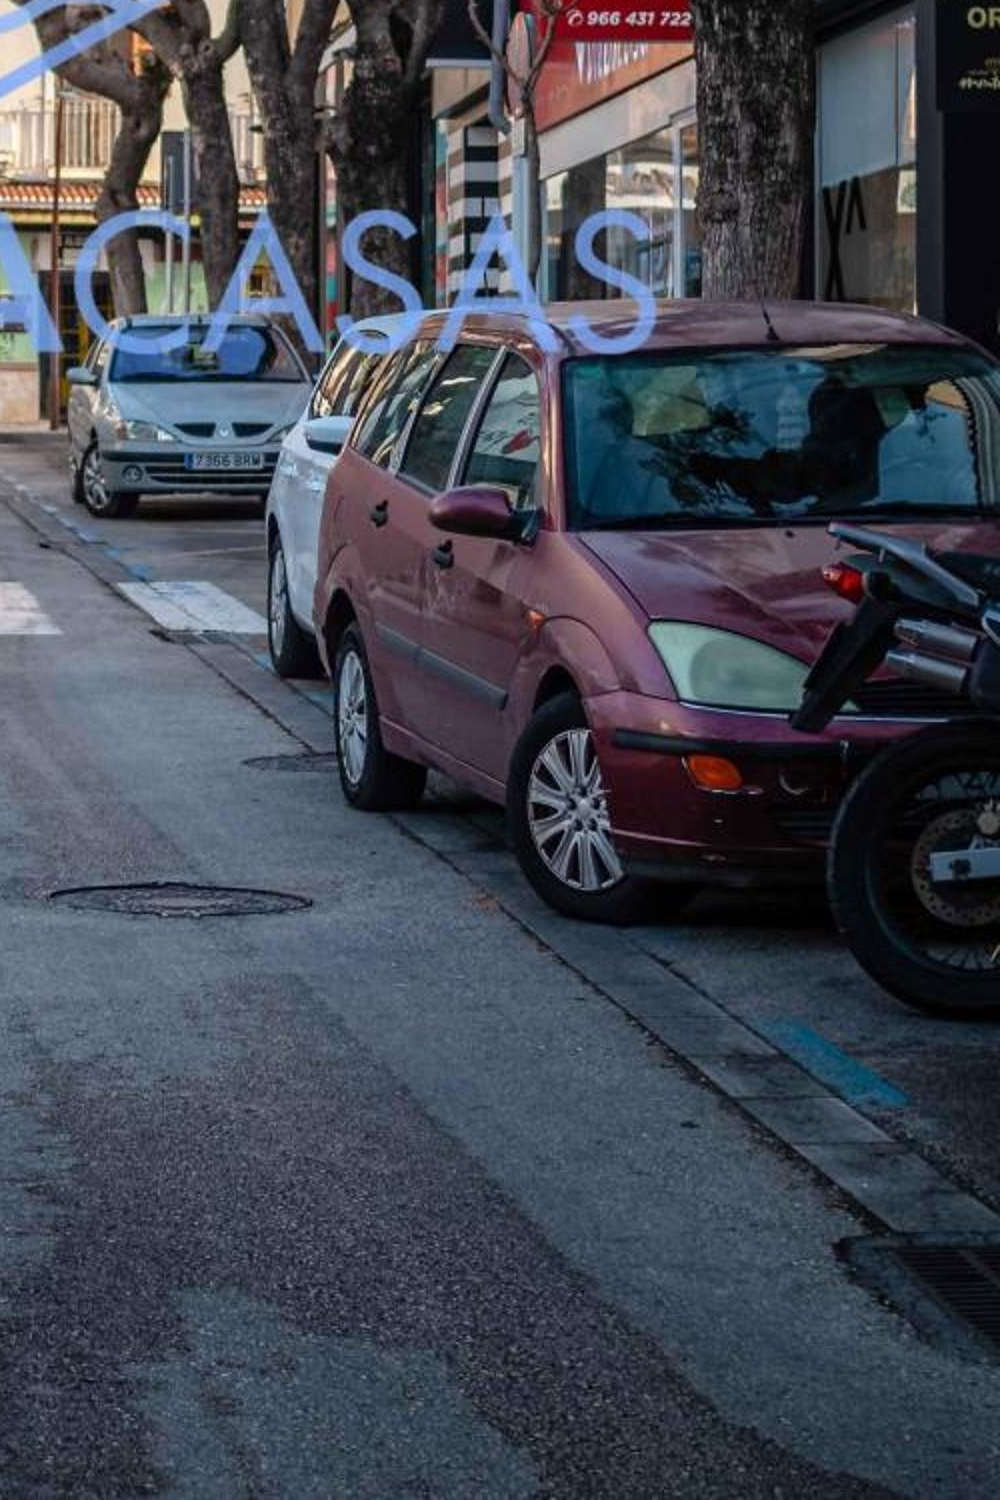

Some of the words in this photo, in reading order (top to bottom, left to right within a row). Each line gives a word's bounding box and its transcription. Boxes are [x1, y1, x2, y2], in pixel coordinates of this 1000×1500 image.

[587, 11, 620, 26] 966
[625, 11, 655, 26] 431
[660, 11, 692, 26] 722
